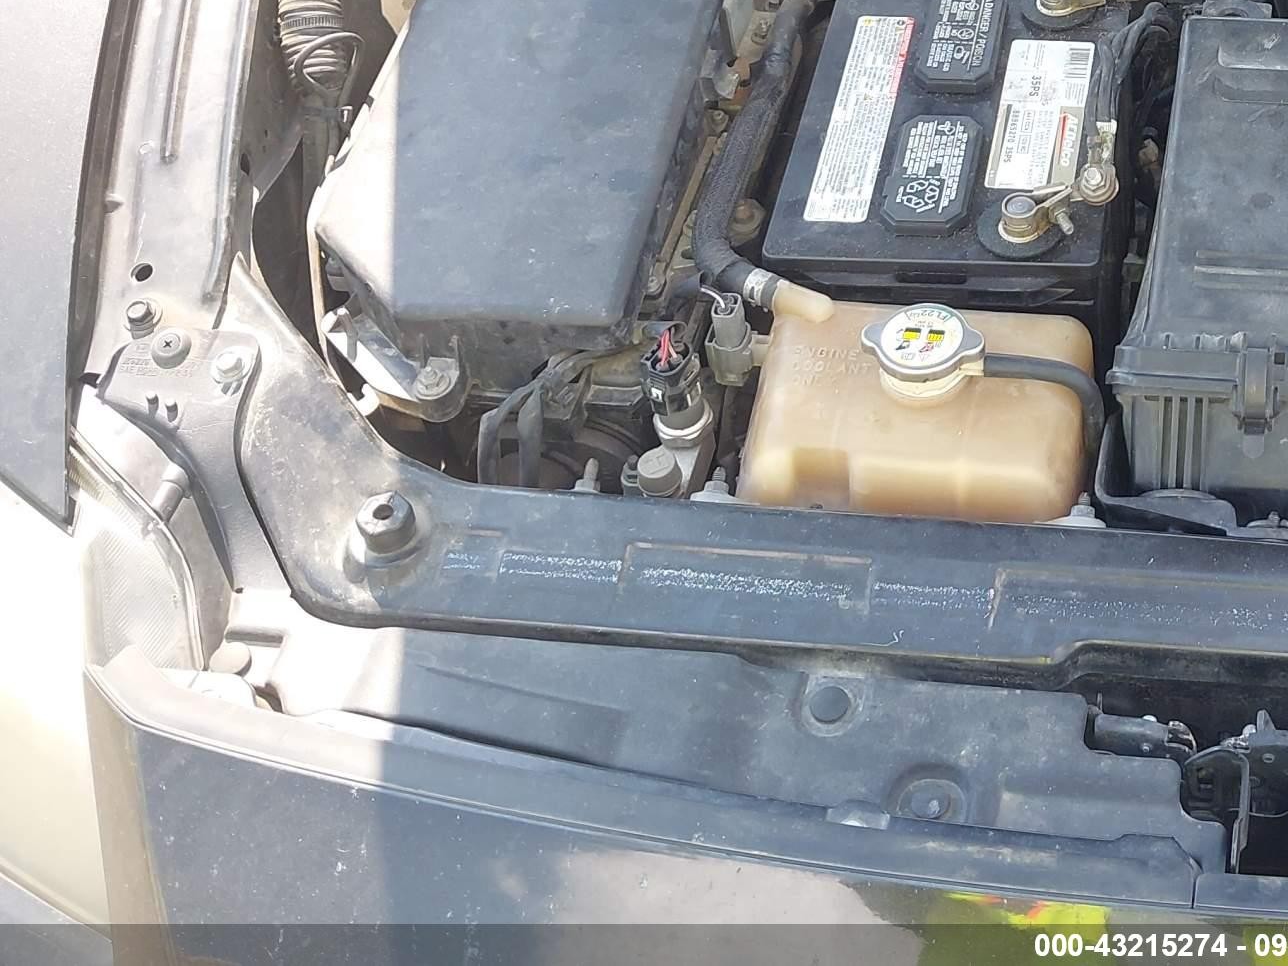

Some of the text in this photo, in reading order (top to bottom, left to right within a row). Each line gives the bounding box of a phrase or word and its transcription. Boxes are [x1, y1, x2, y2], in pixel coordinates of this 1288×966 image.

[979, 2, 994, 33] DANGER
[971, 38, 986, 67] POISON
[1029, 75, 1042, 97] 35PS
